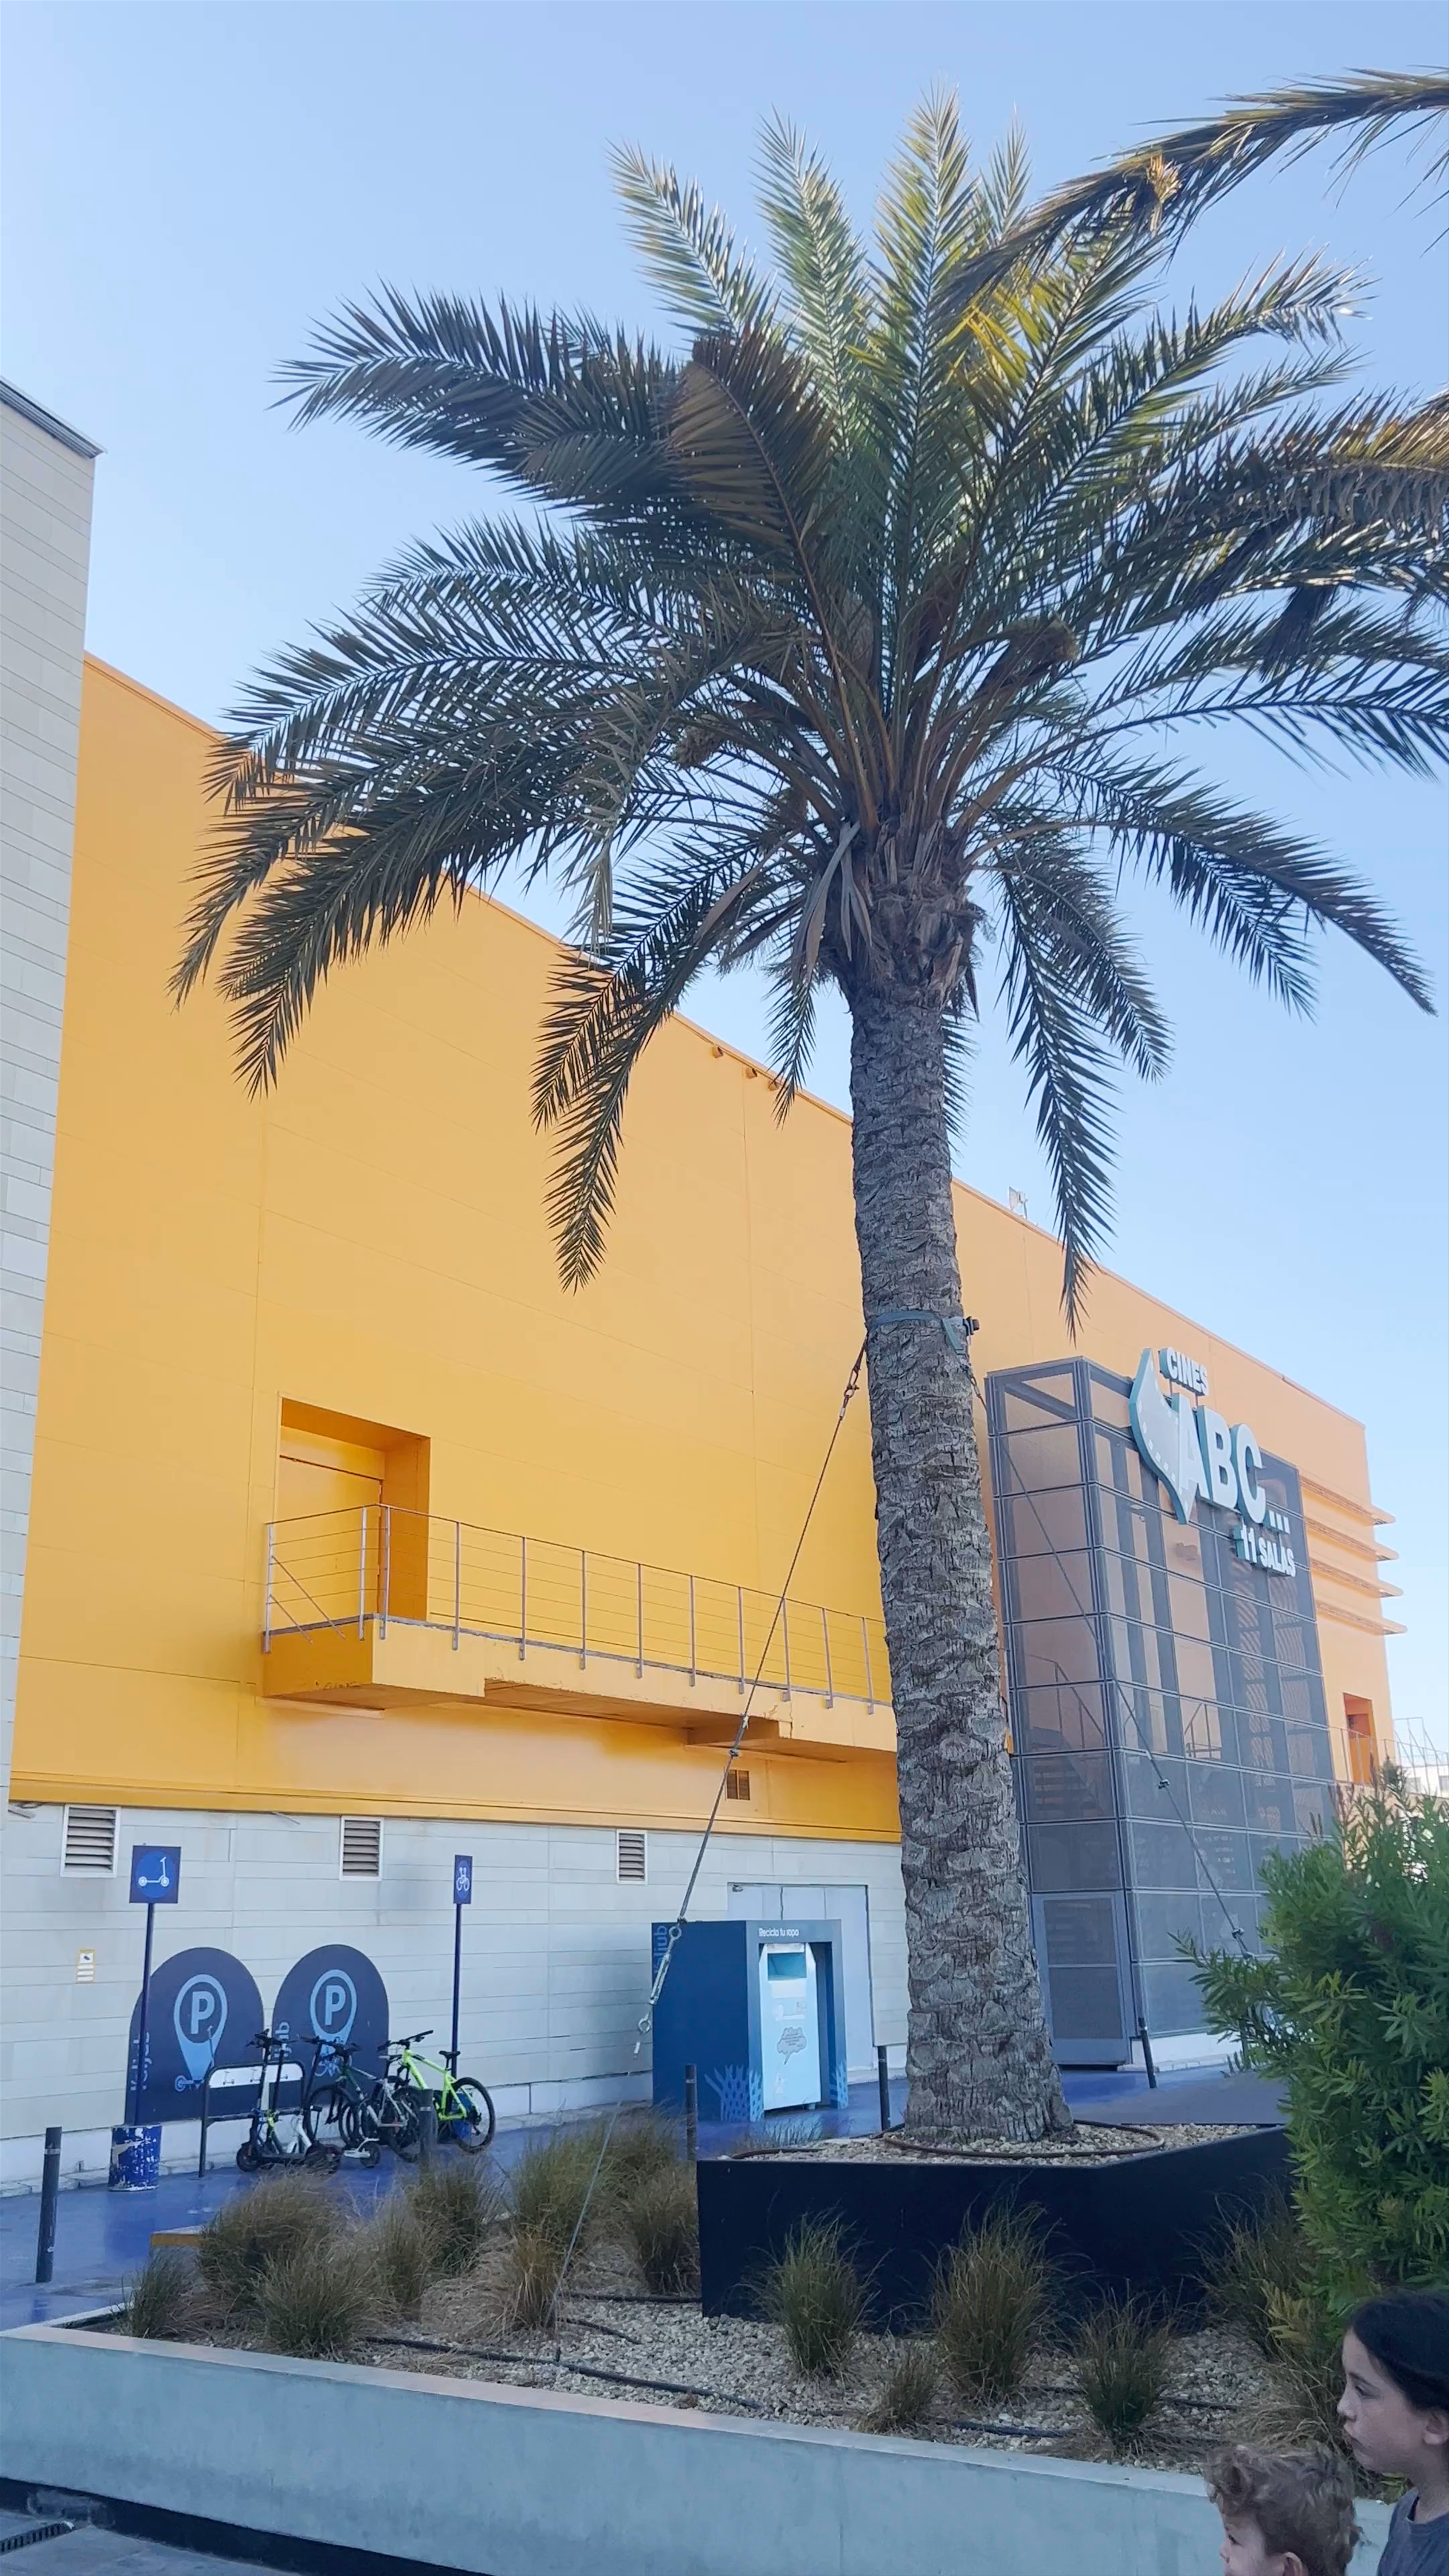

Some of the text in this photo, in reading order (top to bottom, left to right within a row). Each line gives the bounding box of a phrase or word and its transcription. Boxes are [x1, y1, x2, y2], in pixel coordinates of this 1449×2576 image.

[1161, 1347, 1209, 1396] CINES
[1238, 1523, 1296, 1577] 11 SALAS
[190, 1990, 215, 2034] P
[325, 1985, 346, 2025] P
